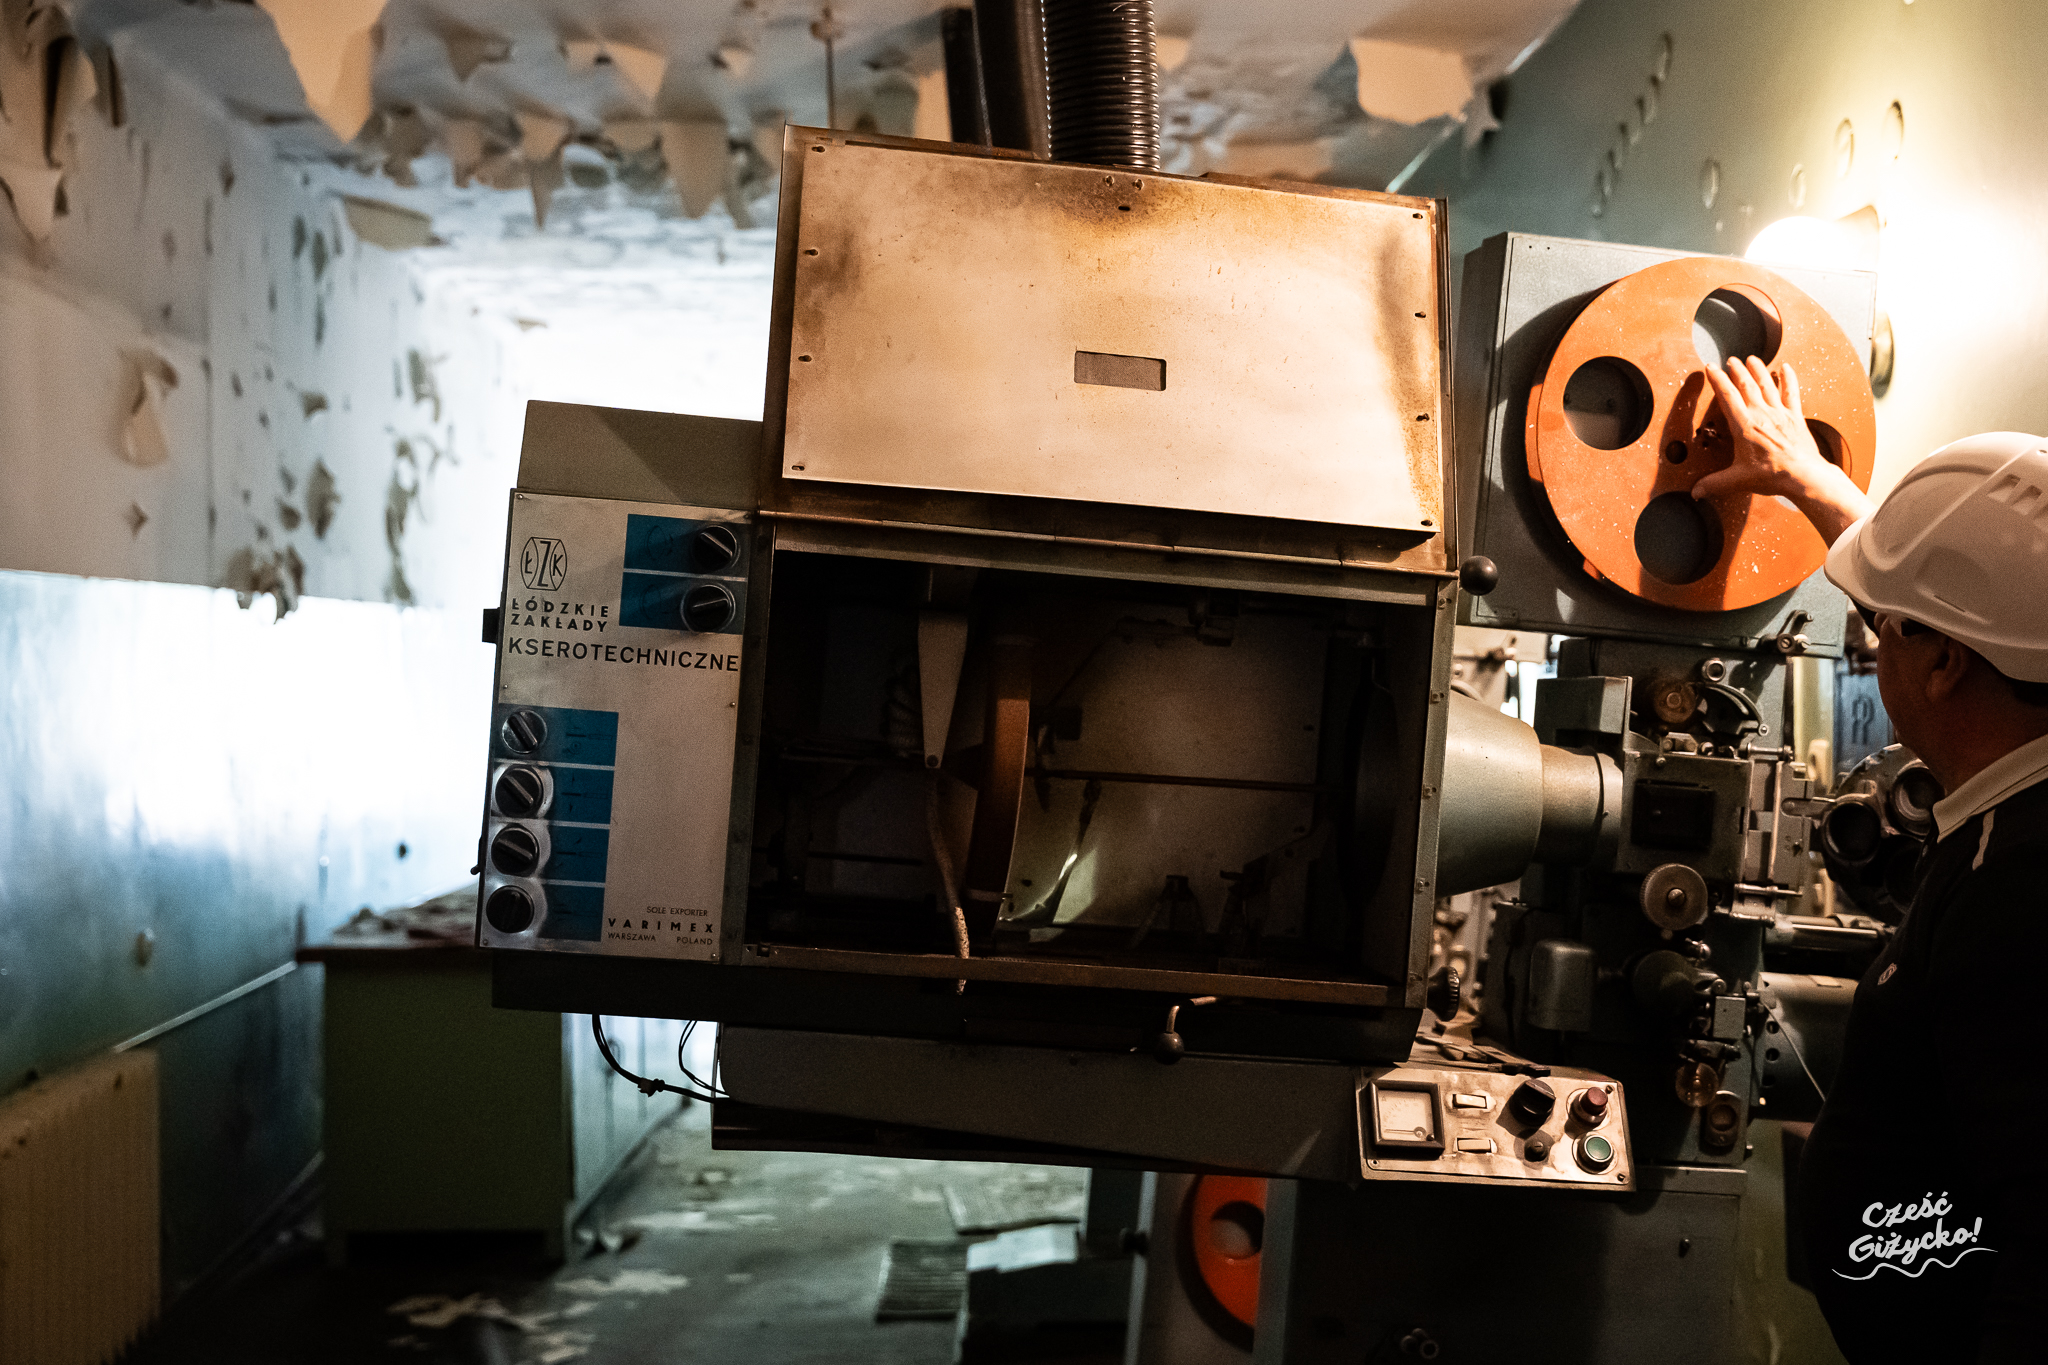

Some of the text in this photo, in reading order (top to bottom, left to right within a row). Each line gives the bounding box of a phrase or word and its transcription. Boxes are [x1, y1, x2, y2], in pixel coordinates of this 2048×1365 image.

[512, 596, 609, 618] ŁÓDZKIE
[510, 613, 608, 633] ZAKŁADY
[508, 636, 739, 672] KSEROTECHNICZNE
[647, 906, 708, 916] SOLE EXPORTER
[608, 918, 713, 933] VARIMEX
[608, 932, 713, 945] WARSZAWA POLAND
